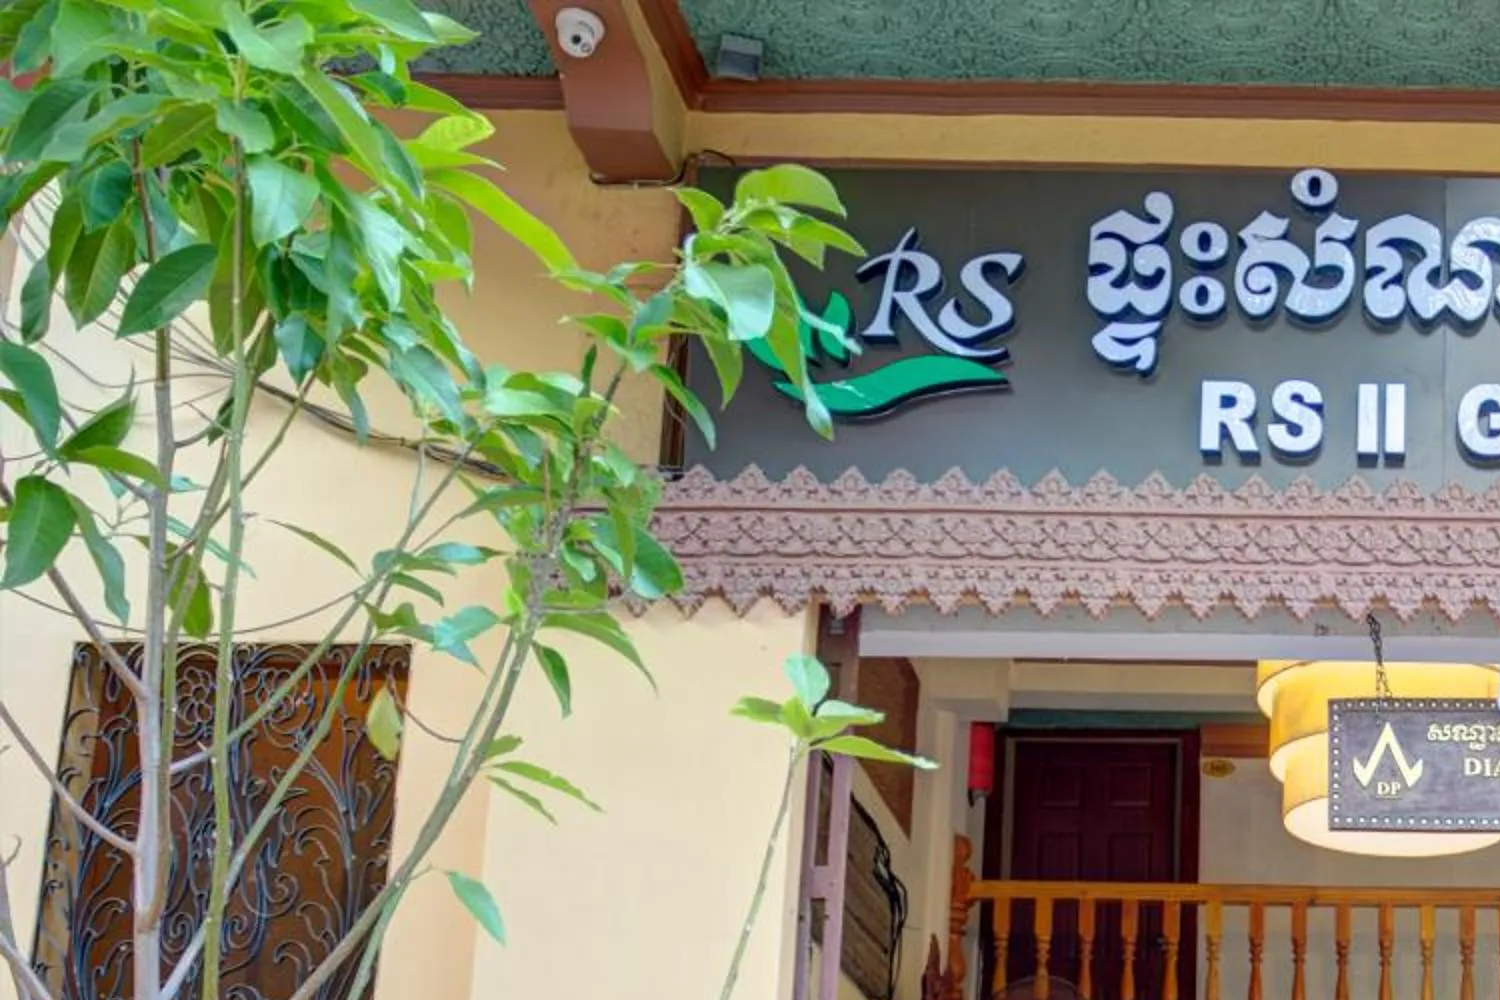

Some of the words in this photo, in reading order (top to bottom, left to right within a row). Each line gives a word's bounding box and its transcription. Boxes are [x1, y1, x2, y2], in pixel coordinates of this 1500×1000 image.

[855, 226, 1026, 362] RS
[1200, 379, 1325, 465] RS
[1376, 780, 1401, 797] DP
